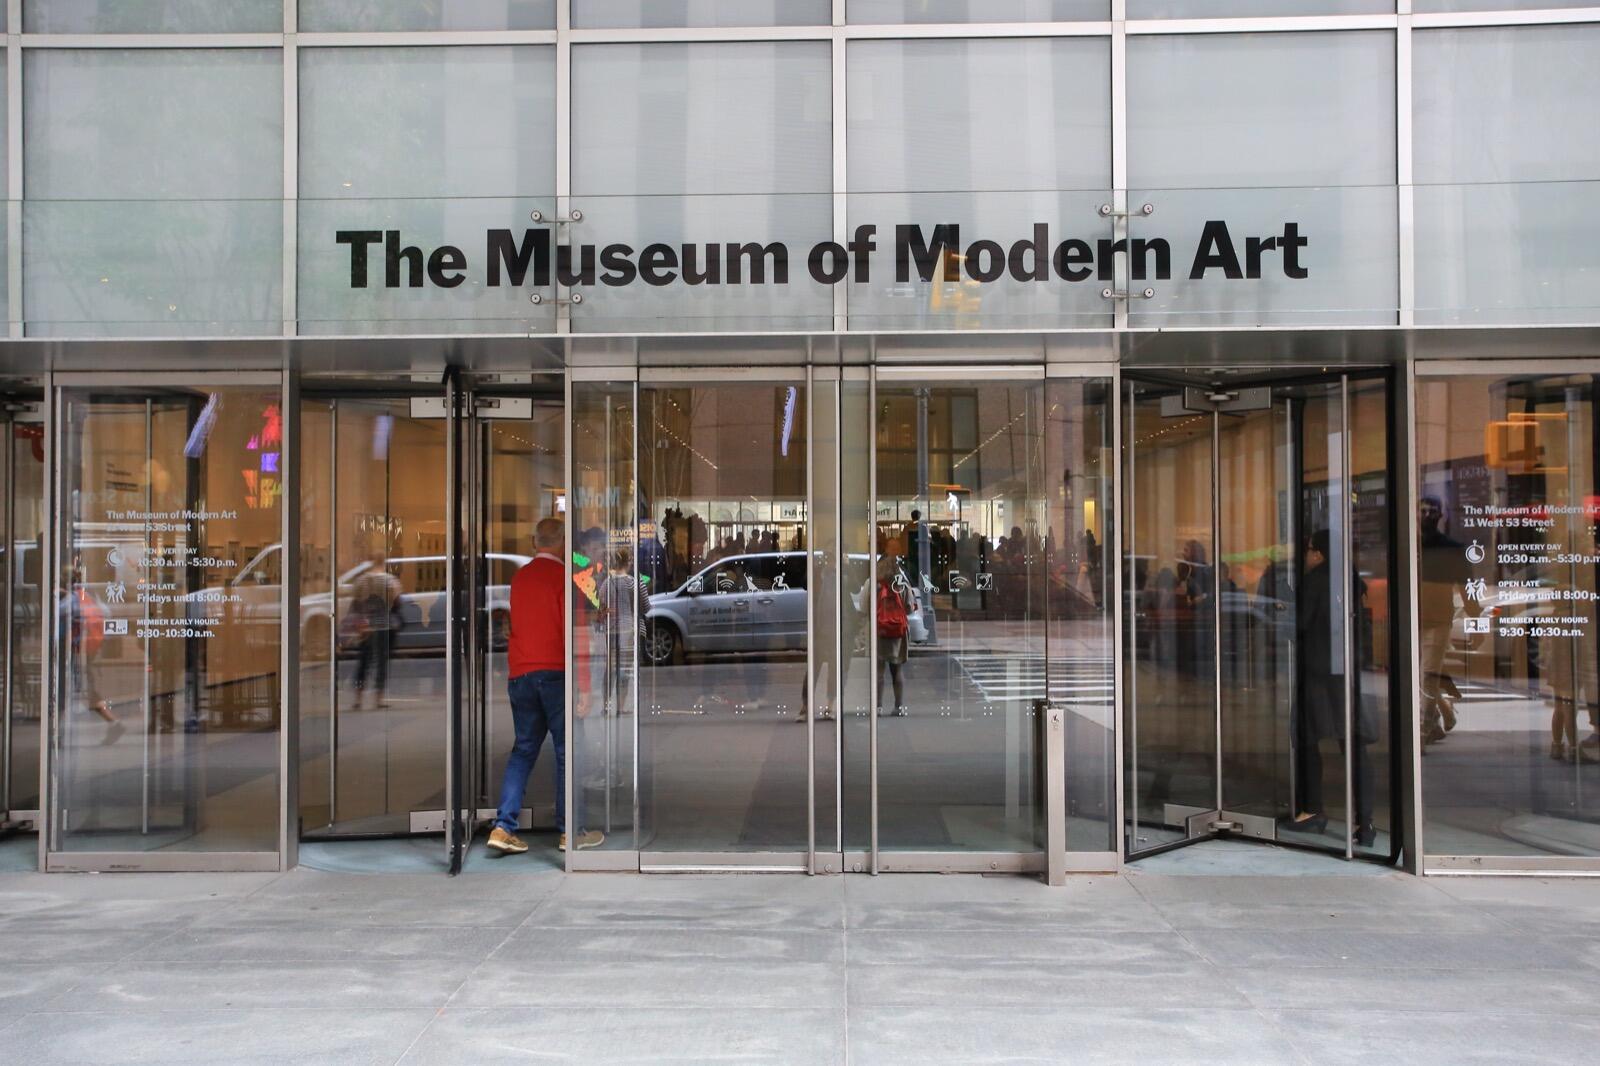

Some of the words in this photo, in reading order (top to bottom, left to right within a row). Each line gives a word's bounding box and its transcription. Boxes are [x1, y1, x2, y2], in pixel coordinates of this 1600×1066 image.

[336, 230, 467, 288] The
[487, 228, 788, 287] Museum
[808, 224, 876, 285] of
[895, 222, 1171, 283] Modern
[1189, 220, 1308, 280] Art
[106, 510, 124, 520] The
[127, 510, 168, 520] Museum
[170, 510, 180, 520] of
[182, 510, 219, 520] Modern
[221, 510, 238, 520] Art
[1464, 505, 1483, 515] The
[1485, 505, 1530, 515] Museum
[1531, 505, 1543, 515] of
[1544, 505, 1585, 515] Modern
[1464, 518, 1475, 527] 11
[1478, 518, 1504, 527] West
[1506, 518, 1519, 527] 53
[1521, 518, 1555, 527] Street
[137, 557, 166, 567] 10:30
[216, 558, 238, 569] p.m.
[1498, 554, 1528, 564] 10:30
[1498, 580, 1520, 588] OPEN
[1521, 580, 1540, 588] LATE
[137, 593, 171, 603] Fridays
[173, 593, 196, 602] until
[197, 593, 221, 602] 8:00
[222, 594, 243, 604] p.m.
[1498, 590, 1538, 602] Fridays
[1538, 590, 1561, 600] until
[1563, 590, 1589, 601] 8:00
[137, 618, 169, 626] MEMBER
[195, 630, 216, 638] a.m.
[1562, 629, 1585, 637] a.m.
